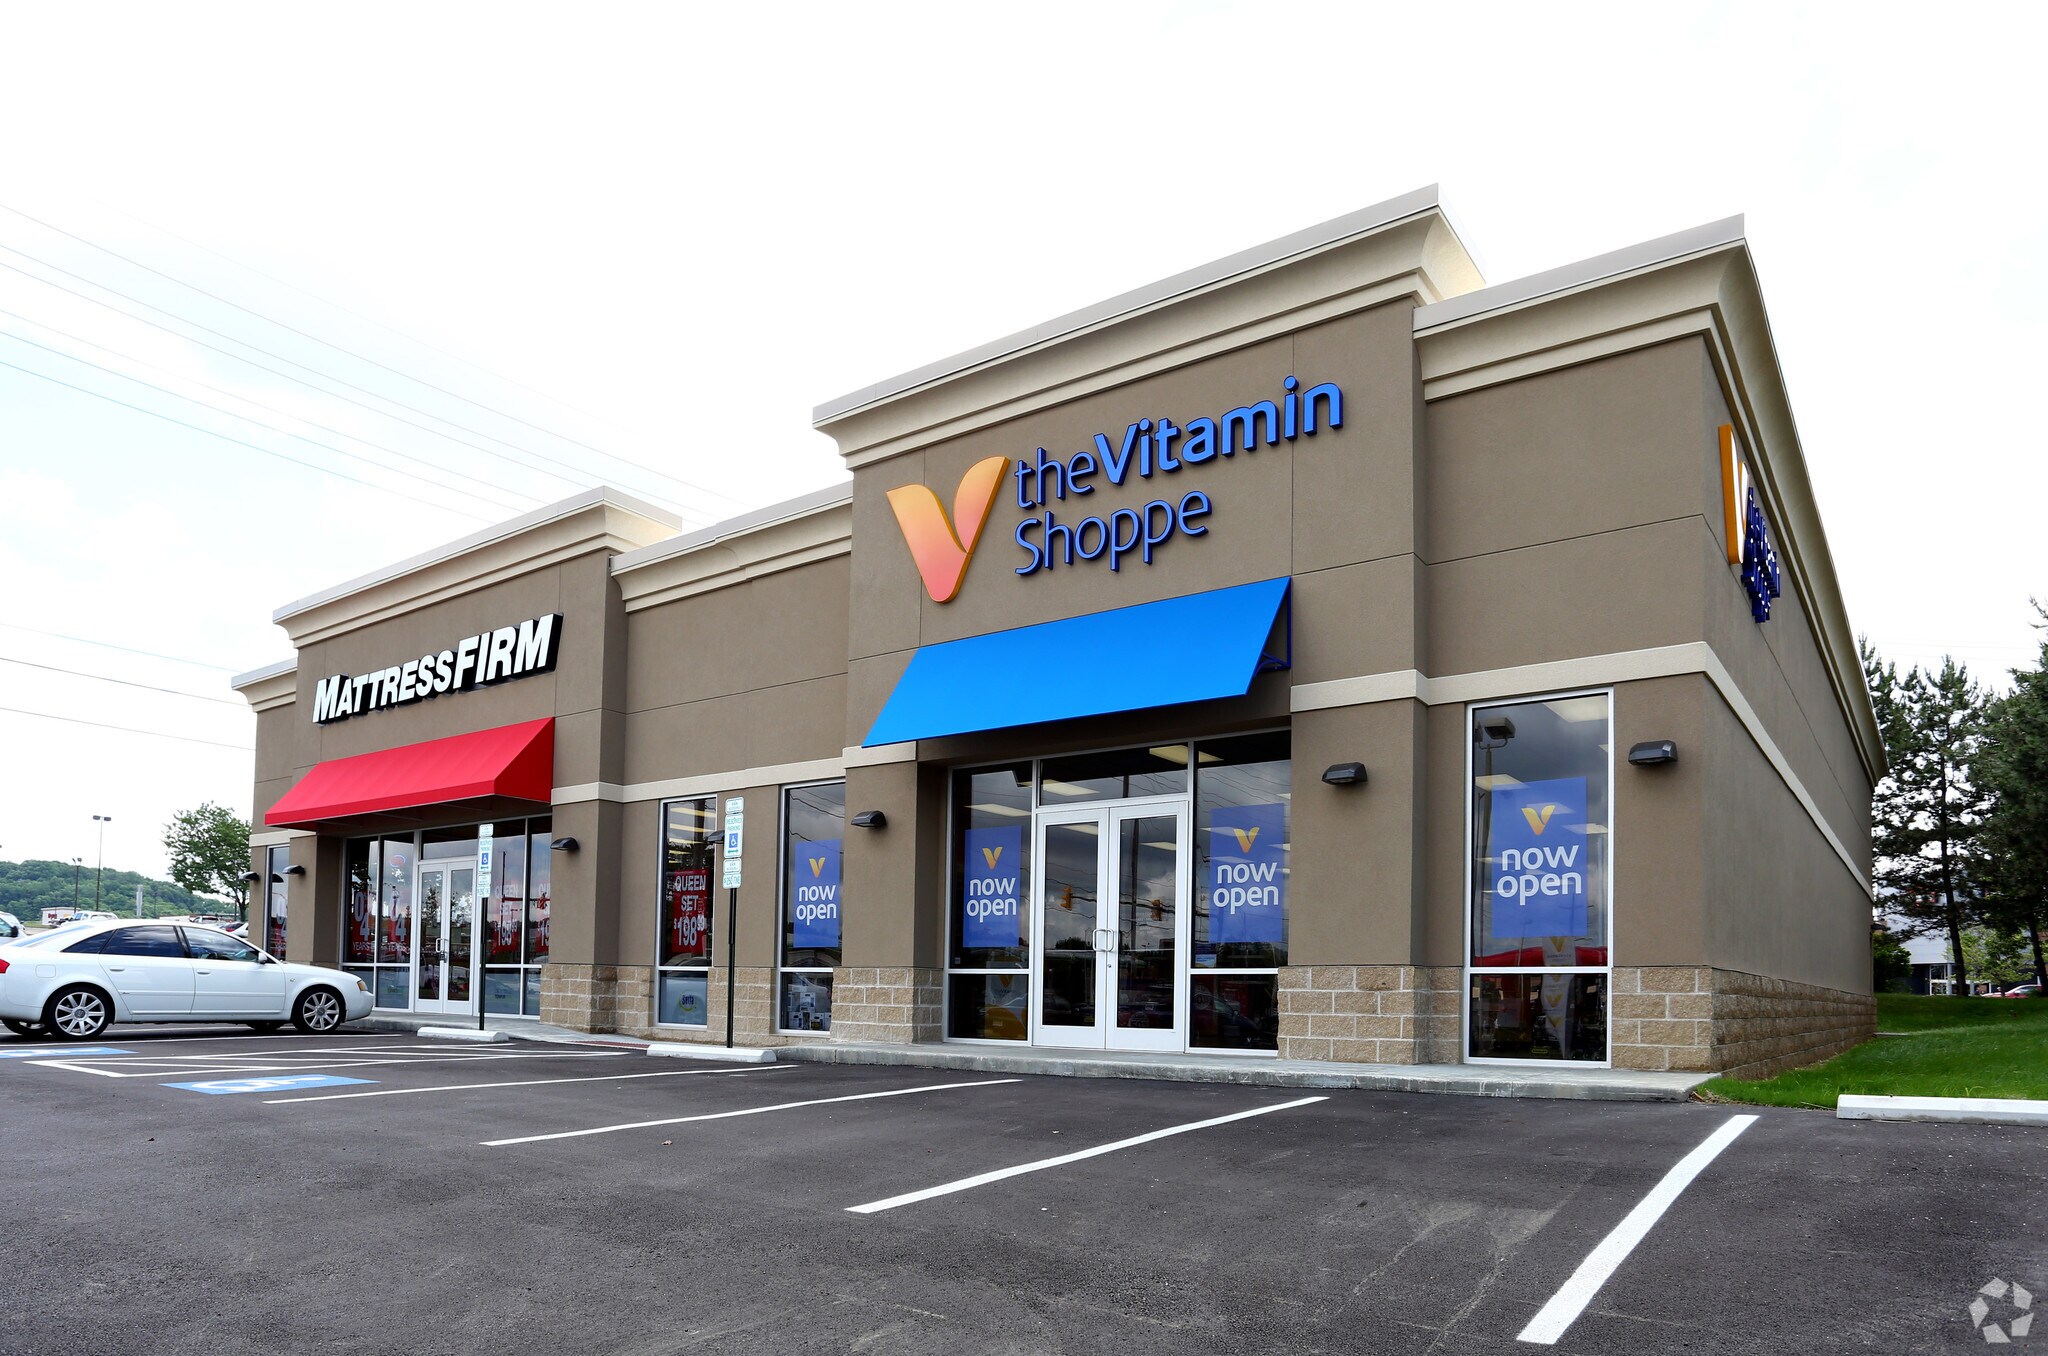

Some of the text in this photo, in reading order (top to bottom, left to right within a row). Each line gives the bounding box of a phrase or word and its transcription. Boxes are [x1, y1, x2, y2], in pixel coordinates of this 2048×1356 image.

[1014, 490, 1213, 576] Shoppe
[1501, 844, 1580, 871] now
[675, 875, 706, 892] QUEEN
[1217, 862, 1278, 884] now
[798, 885, 836, 902] now
[969, 877, 1016, 896] now
[1497, 871, 1582, 906] open
[681, 895, 699, 912] SET
[966, 898, 1017, 922] open
[1213, 885, 1279, 915] open
[796, 903, 837, 925] open
